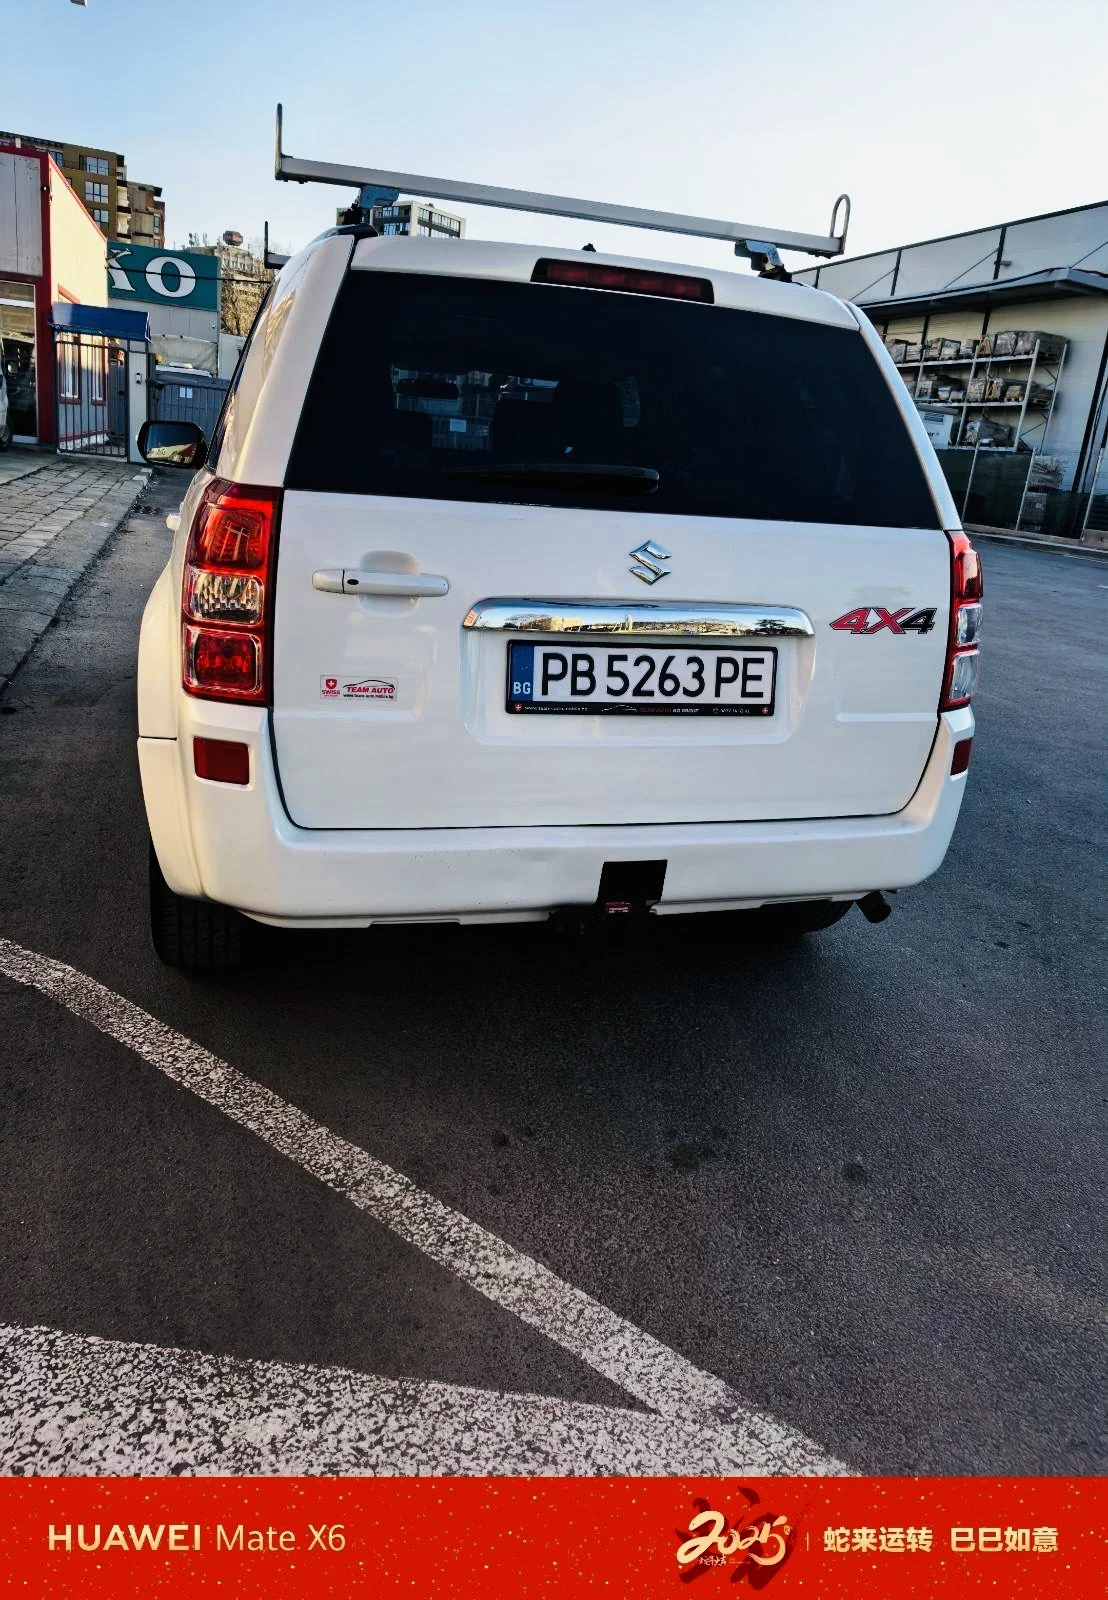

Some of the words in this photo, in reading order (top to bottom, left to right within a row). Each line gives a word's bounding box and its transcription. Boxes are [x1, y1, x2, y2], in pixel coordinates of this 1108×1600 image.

[829, 607, 938, 634] 4X4
[512, 681, 531, 695] BG
[541, 652, 597, 696] PB
[606, 653, 705, 698] 5263
[714, 656, 765, 698] PE
